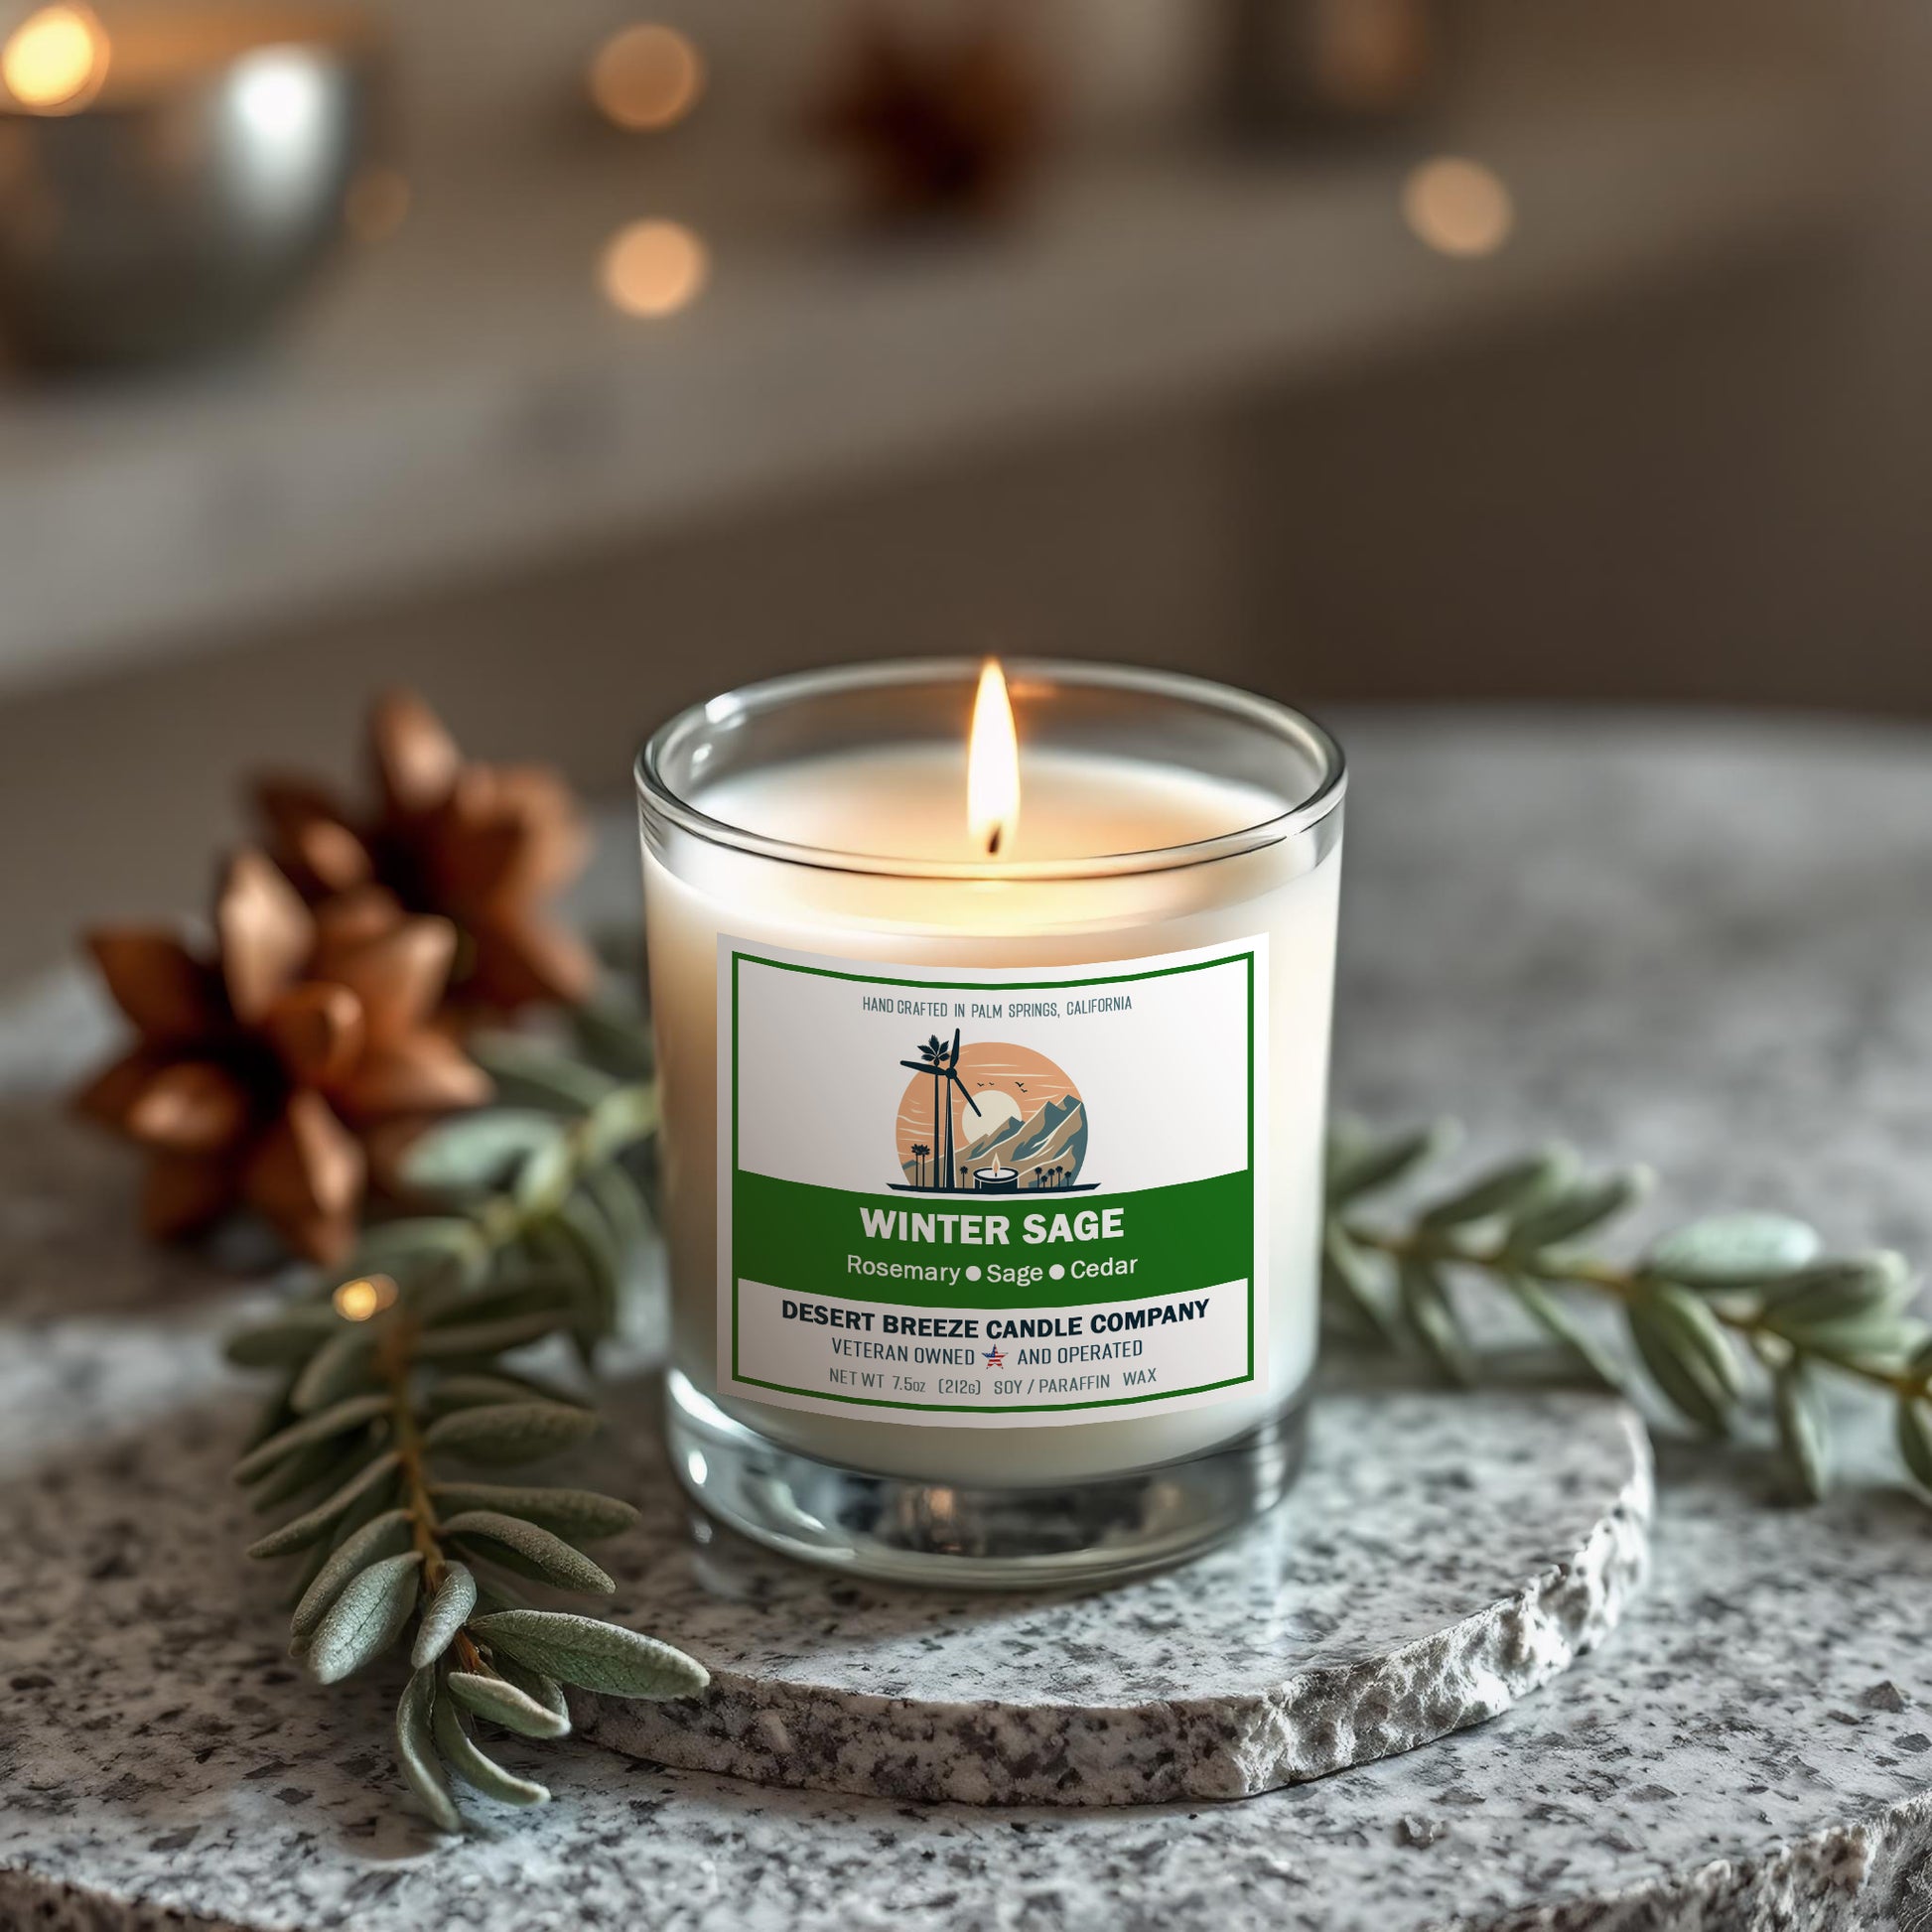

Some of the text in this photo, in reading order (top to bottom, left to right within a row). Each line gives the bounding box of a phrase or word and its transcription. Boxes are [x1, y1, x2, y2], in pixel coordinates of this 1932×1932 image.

[863, 996, 1132, 1019] HAND CRAFTED IN PALM SPRINGS, CALIFORNIA
[860, 1207, 1124, 1244] WINTER SAGE
[848, 1255, 1138, 1287] Rosemary Sage Cedar
[782, 1298, 1209, 1339] DESERT BREEZE CANDLE COMPANY
[832, 1337, 1142, 1365] VETERAN OWNED AND OPERATED
[830, 1368, 857, 1385] NET
[861, 1372, 884, 1388] WT
[995, 1380, 1023, 1395] SOY
[1039, 1374, 1109, 1393] PARAFFIN
[1123, 1368, 1157, 1386] WAX
